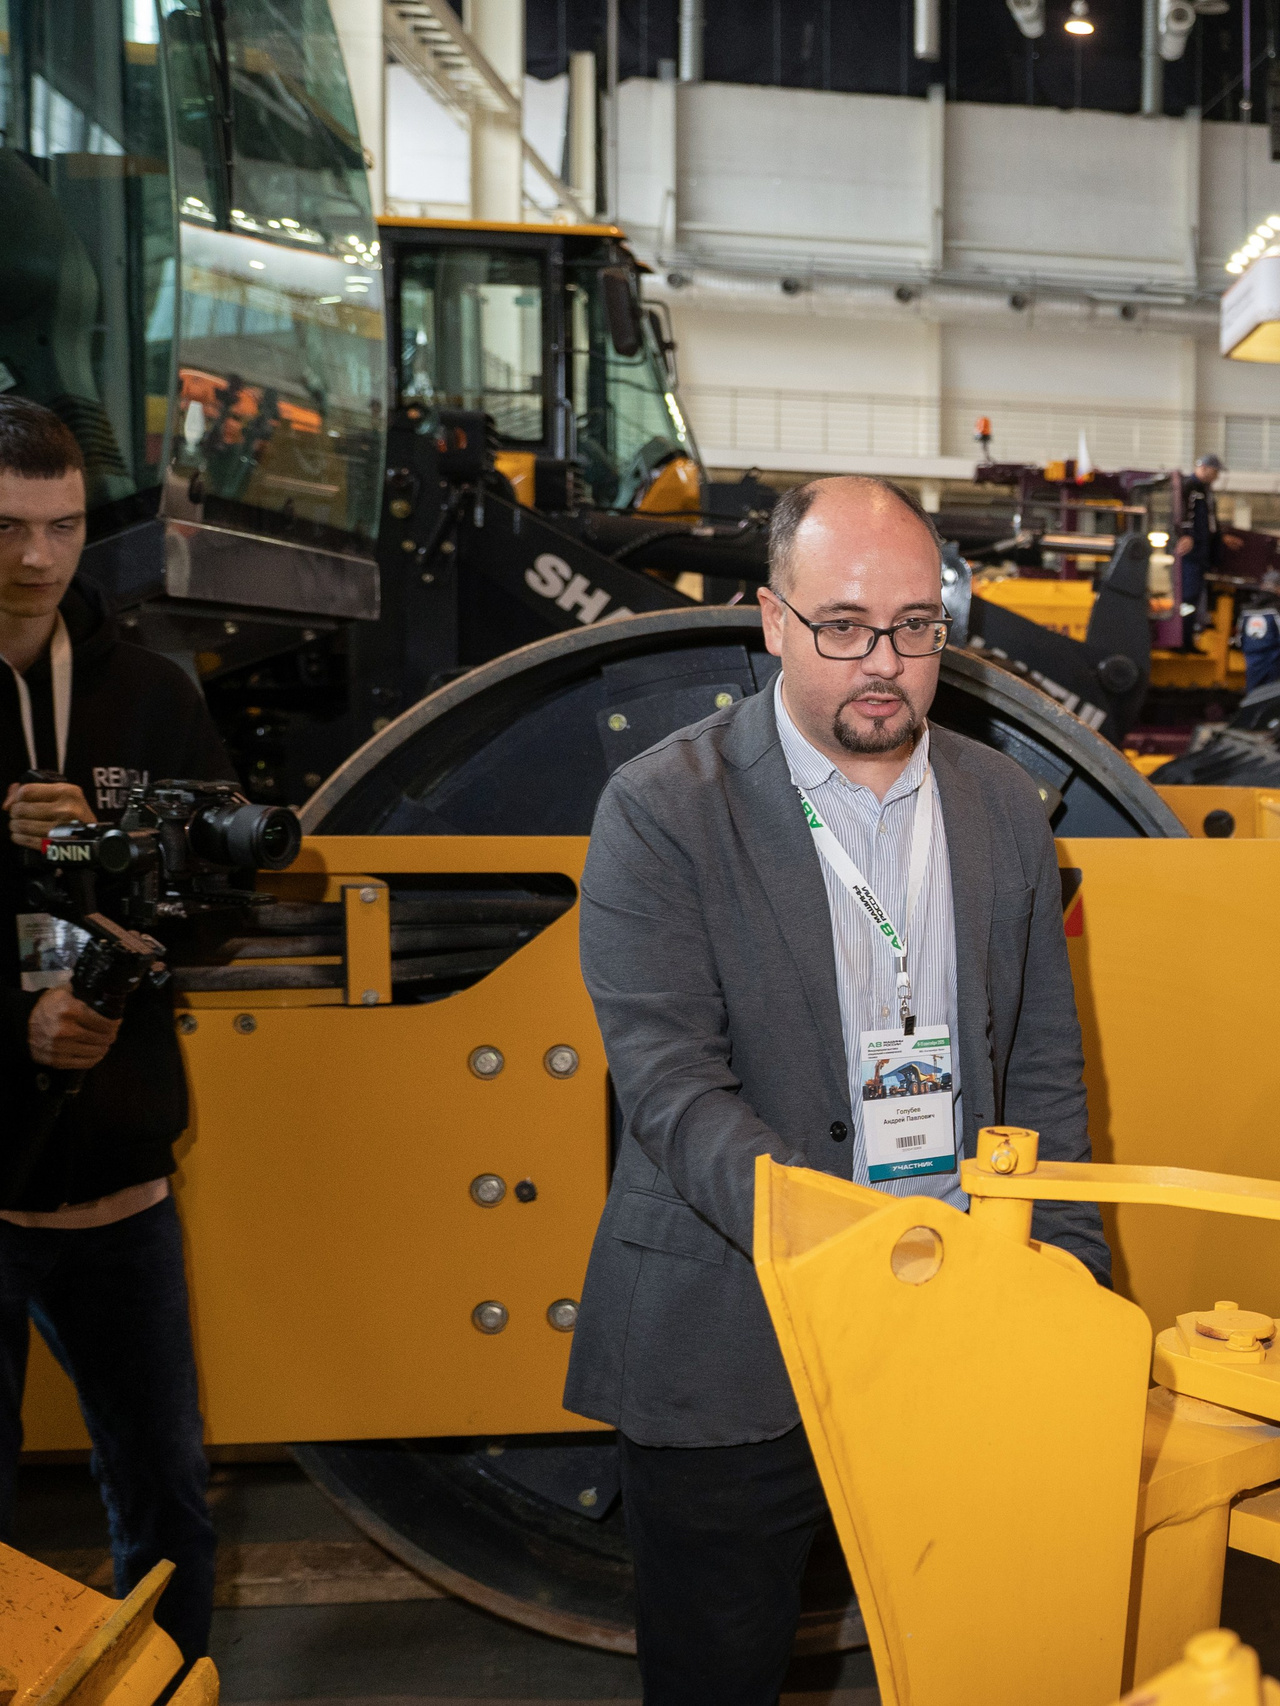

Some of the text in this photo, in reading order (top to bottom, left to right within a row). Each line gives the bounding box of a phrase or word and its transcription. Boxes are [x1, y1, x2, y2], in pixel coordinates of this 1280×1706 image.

[852, 886, 881, 924] МАШИНЫ
[861, 886, 887, 922] РОССИИ
[896, 1107, 921, 1115] Голубев
[883, 1113, 935, 1125] Андрей Павлович
[892, 1161, 933, 1171] УЧАСТНИК
